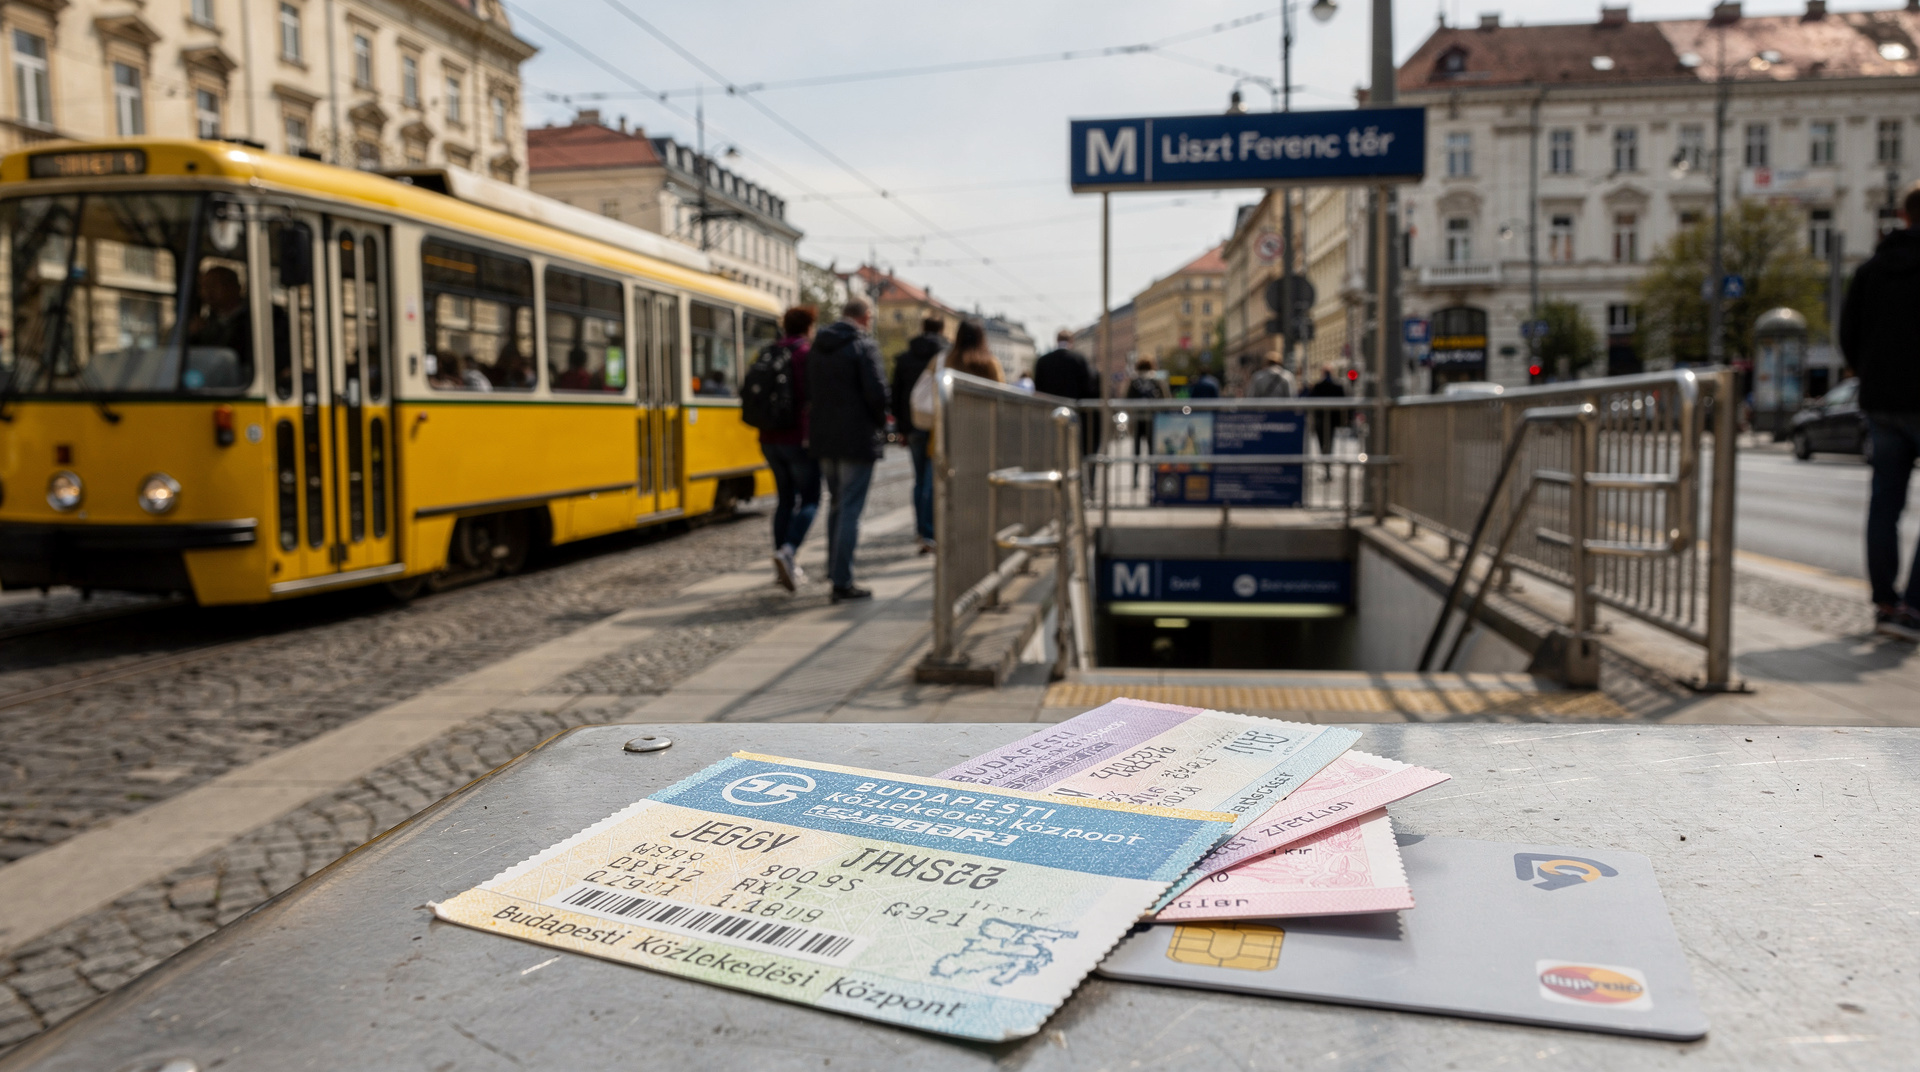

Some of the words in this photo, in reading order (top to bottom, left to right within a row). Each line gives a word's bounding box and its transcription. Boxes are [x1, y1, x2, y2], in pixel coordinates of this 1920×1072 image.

[1085, 125, 1138, 177] M
[1161, 132, 1234, 164] Liszt
[1237, 130, 1342, 161] Ferenc
[1112, 562, 1151, 598] M
[854, 781, 1057, 821] BUDAPESTI
[670, 820, 799, 853] JEGGY
[493, 904, 632, 946] Budapesti
[824, 976, 968, 1020] Központ
